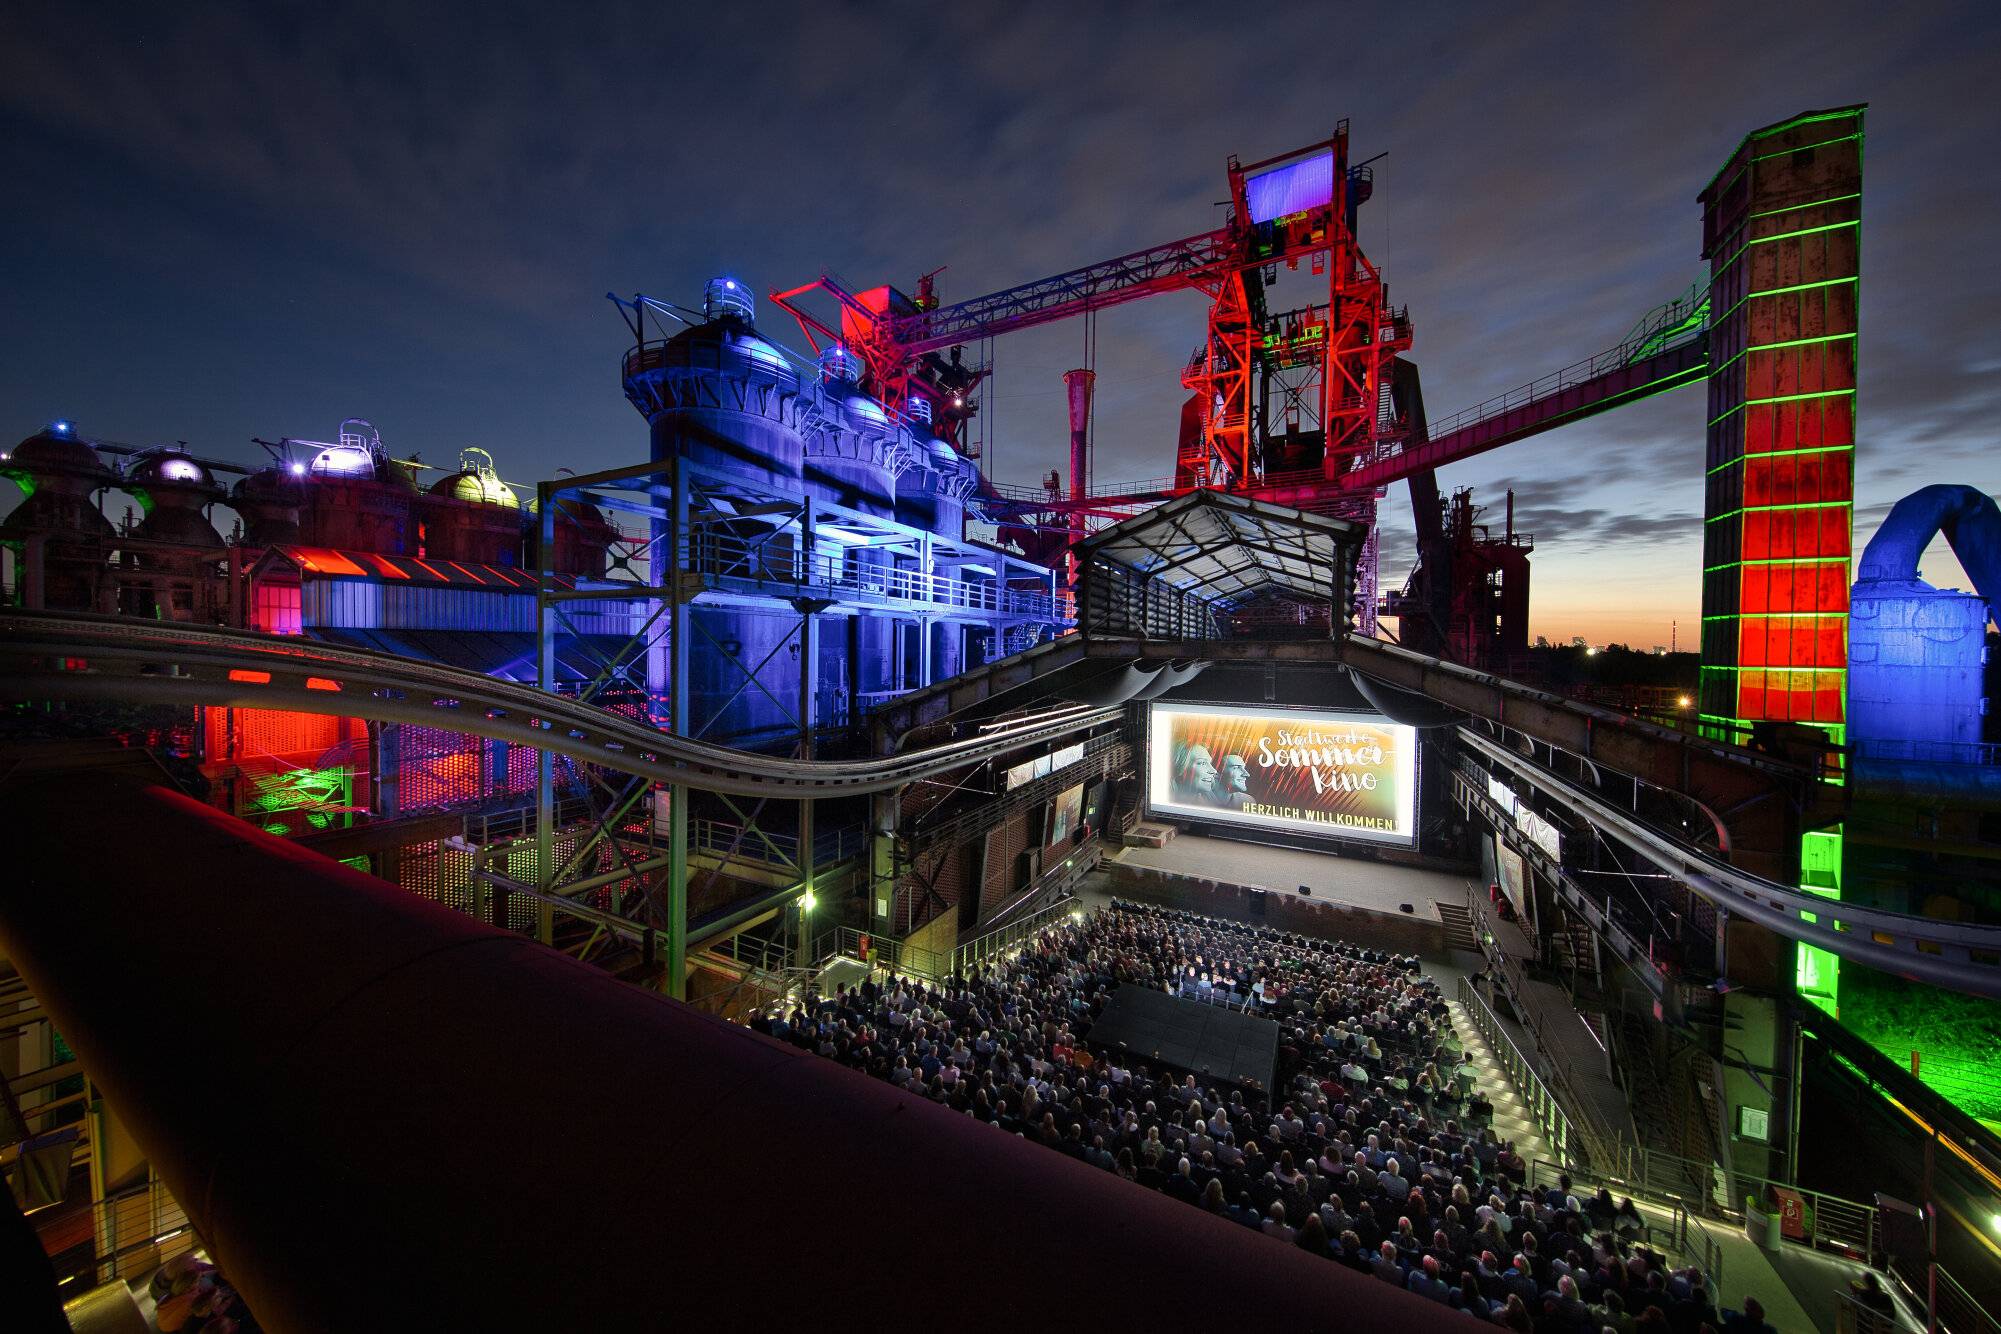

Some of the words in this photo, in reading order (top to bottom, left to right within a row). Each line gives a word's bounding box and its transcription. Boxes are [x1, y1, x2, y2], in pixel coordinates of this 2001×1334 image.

[1258, 736, 1392, 767] Sommer
[1310, 765, 1382, 794] kino
[1243, 802, 1299, 819] HERZLICH
